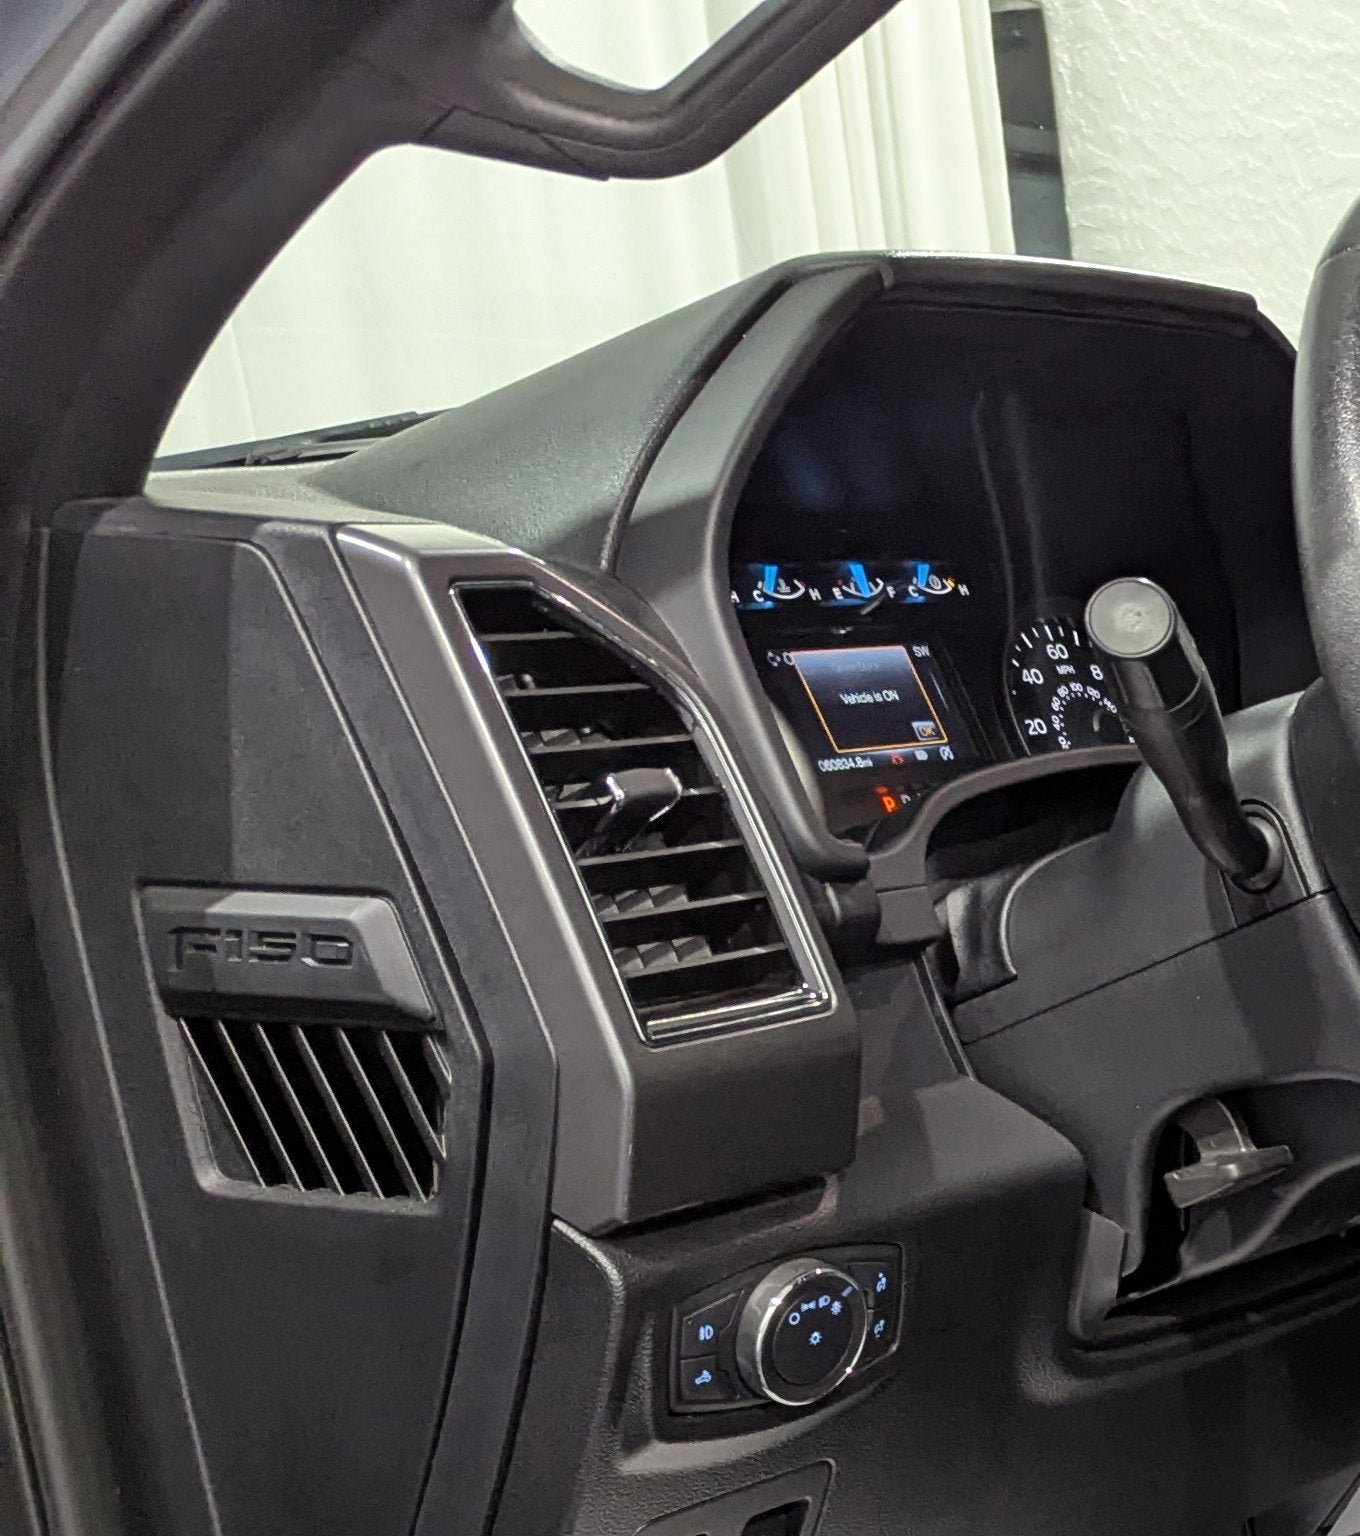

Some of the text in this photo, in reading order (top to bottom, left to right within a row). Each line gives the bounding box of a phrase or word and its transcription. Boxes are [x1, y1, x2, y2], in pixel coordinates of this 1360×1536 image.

[753, 589, 764, 603] C
[809, 587, 822, 601] H
[832, 586, 844, 600] E
[886, 585, 896, 599] F
[908, 585, 918, 597] C
[957, 583, 970, 596] H
[912, 645, 931, 658] SW
[1046, 643, 1069, 660] 60
[1022, 668, 1044, 684] 40
[839, 688, 900, 705] Vehicle is ON
[1024, 718, 1048, 736] 20
